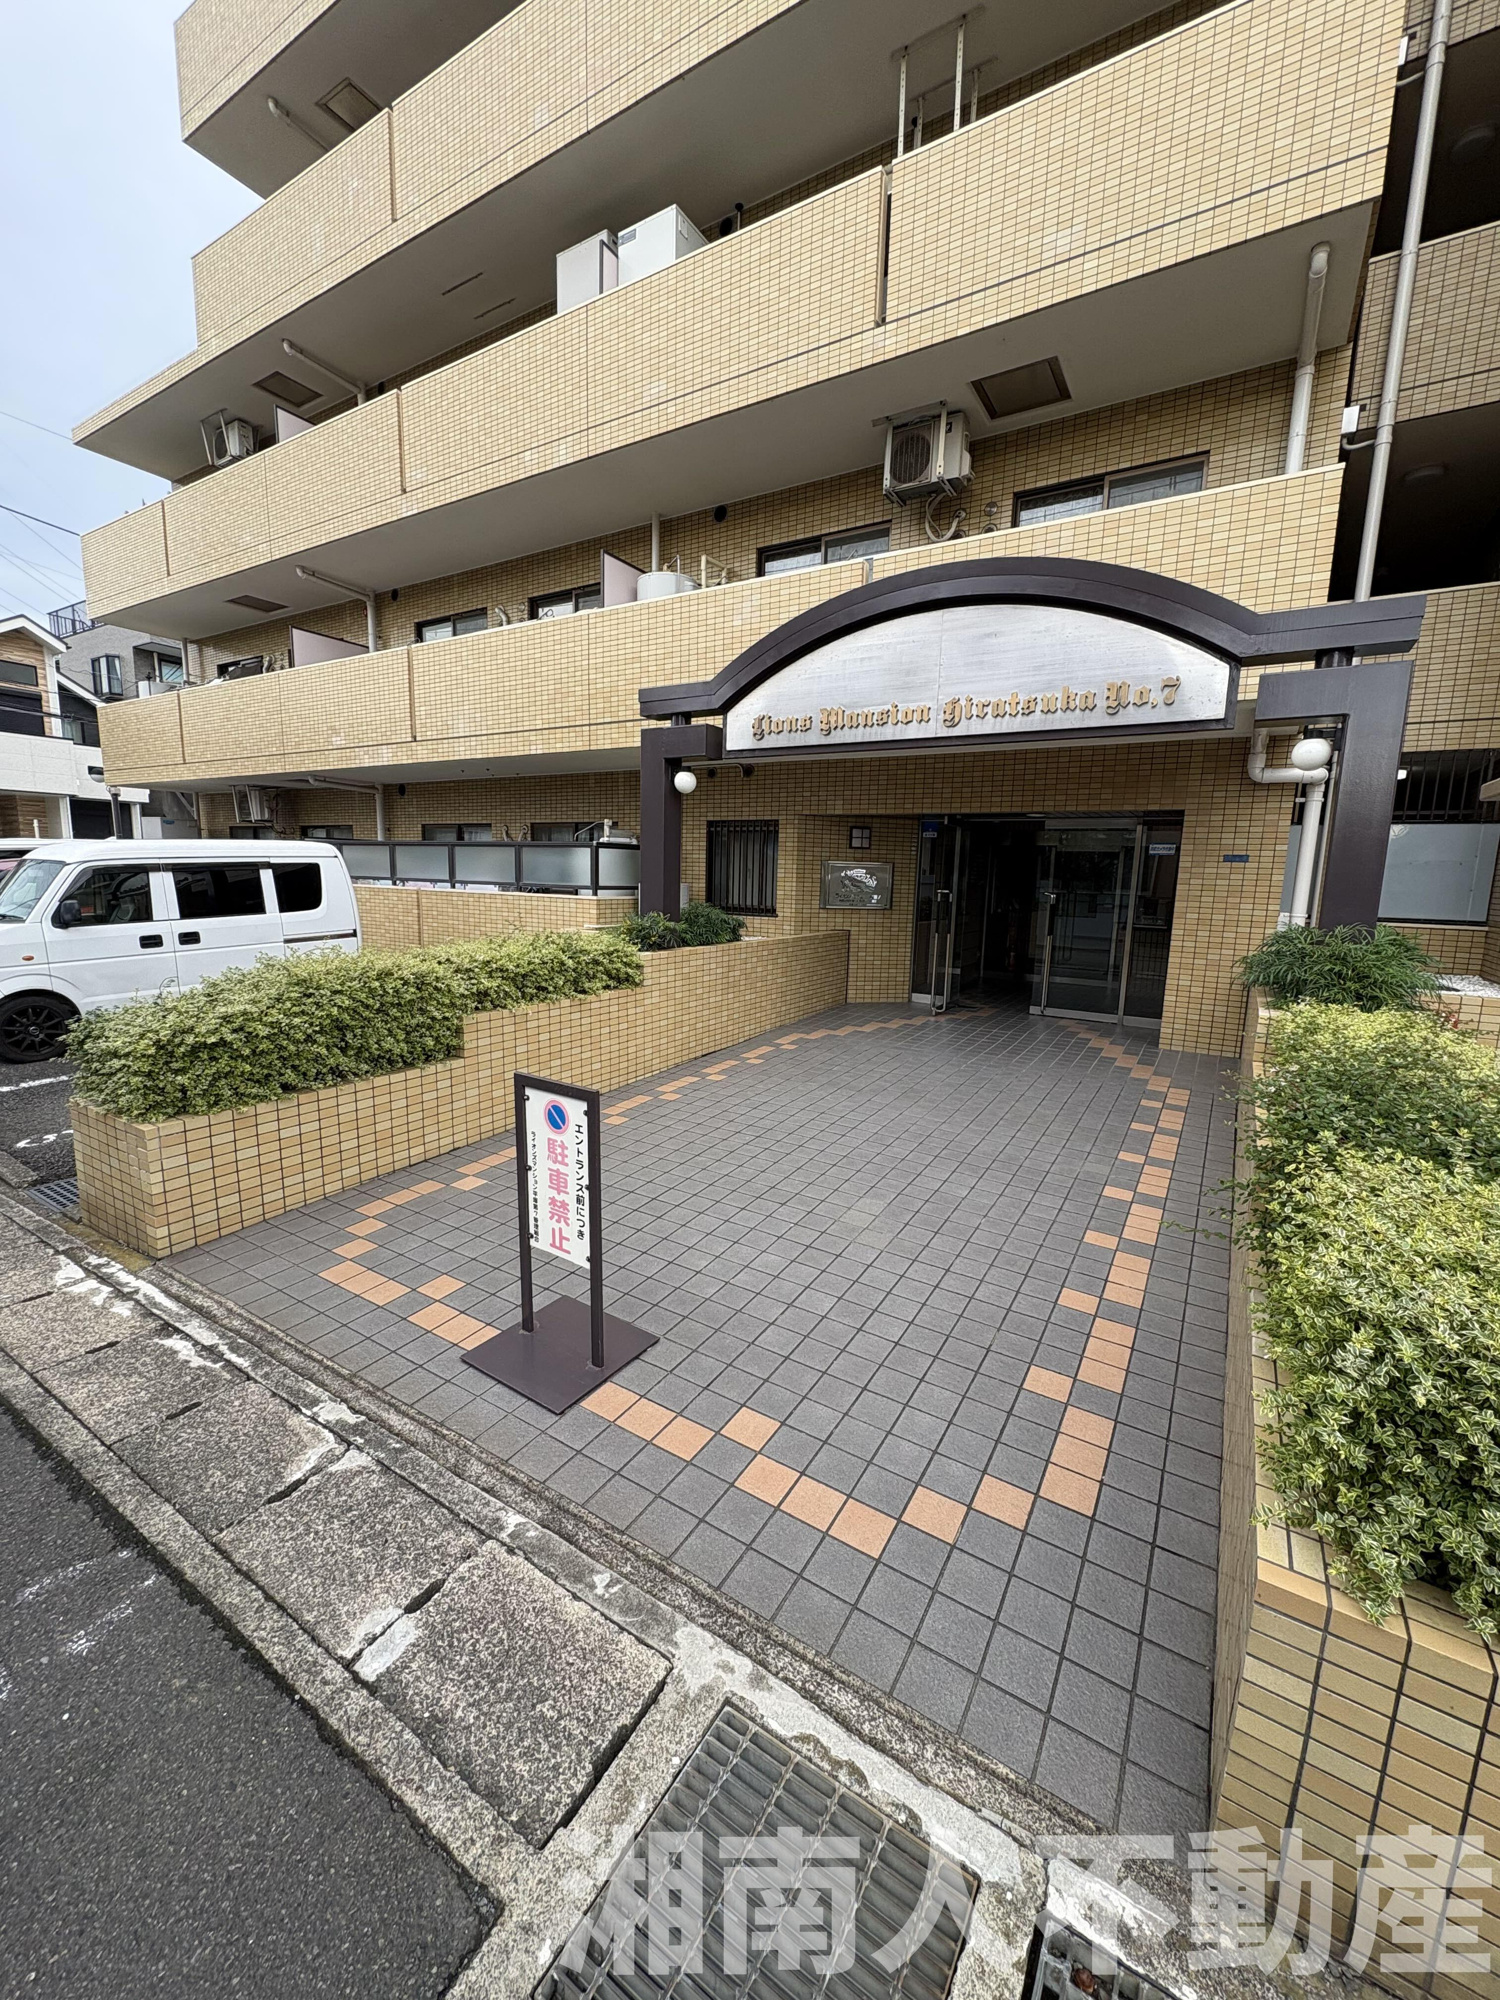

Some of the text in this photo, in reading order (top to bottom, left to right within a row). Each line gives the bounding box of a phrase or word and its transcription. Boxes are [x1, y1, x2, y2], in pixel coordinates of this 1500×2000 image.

[752, 713, 813, 741] Lions
[820, 701, 932, 736] Mansion
[943, 685, 1098, 728] Hiratsuka
[547, 1137, 571, 1254] 駐車禁止
[575, 1124, 586, 1240] エントランス前につき
